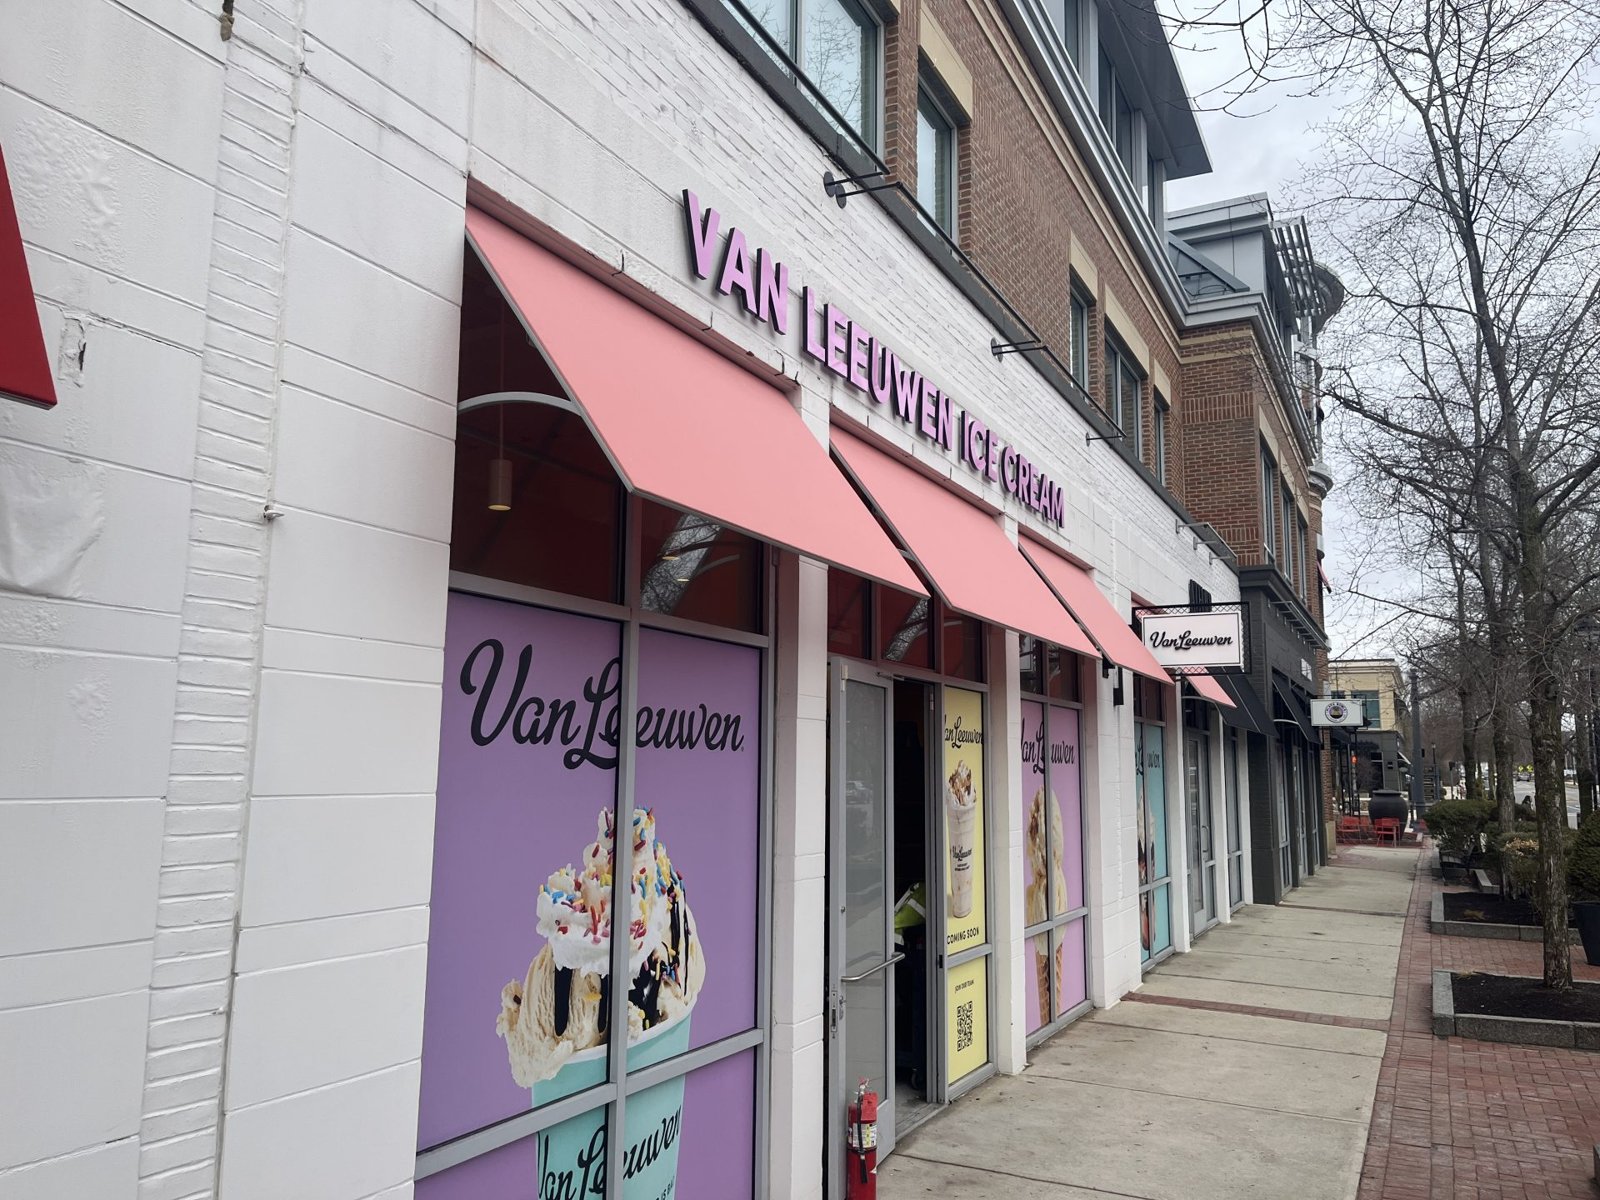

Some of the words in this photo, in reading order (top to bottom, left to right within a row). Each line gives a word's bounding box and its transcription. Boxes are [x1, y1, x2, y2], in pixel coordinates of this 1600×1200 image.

[682, 189, 789, 335] VAN
[802, 286, 954, 450] LEEUWEN
[961, 410, 999, 483] ICE
[1001, 446, 1065, 528] CREAM
[947, 931, 966, 944] COMING
[967, 927, 979, 937] SOON
